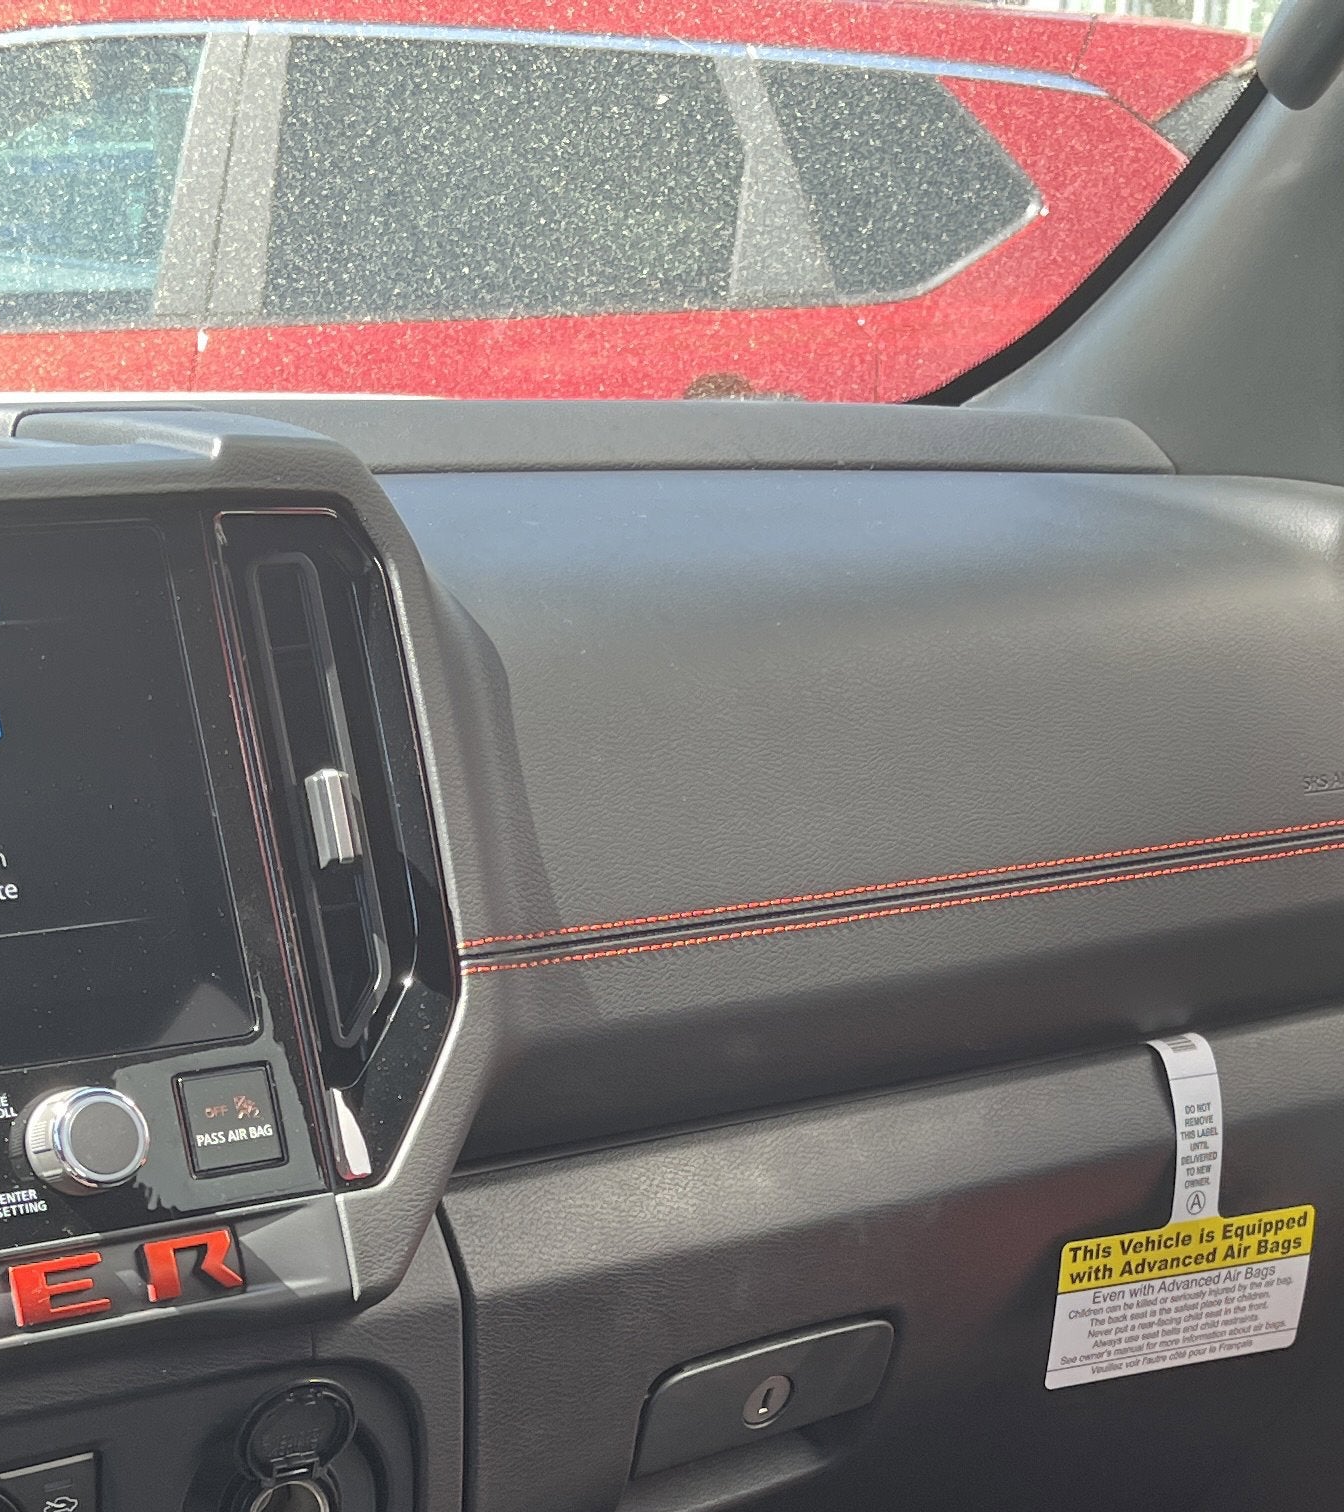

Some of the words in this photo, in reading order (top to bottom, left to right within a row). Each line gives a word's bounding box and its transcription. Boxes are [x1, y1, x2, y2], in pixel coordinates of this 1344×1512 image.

[204, 1104, 229, 1119] OFF
[196, 1131, 226, 1147] PASS
[227, 1128, 249, 1143] AIR
[249, 1124, 274, 1140] BAG
[1068, 1243, 1112, 1264] This
[1118, 1231, 1193, 1257] Vehicle
[1198, 1228, 1216, 1245] is
[1221, 1210, 1308, 1241] Equipped
[1069, 1264, 1113, 1285] with
[1119, 1247, 1217, 1278] Advanced
[1225, 1241, 1252, 1260] Air
[1256, 1235, 1302, 1256] Bags
[1091, 1290, 1126, 1305] Even
[1129, 1284, 1155, 1299] with
[1157, 1271, 1221, 1293] Advanced
[1222, 1268, 1242, 1283] Air
[1244, 1264, 1276, 1281] Bags
[1068, 1305, 1105, 1320] Children
[1105, 1303, 1121, 1313] can
[1122, 1300, 1134, 1311] be
